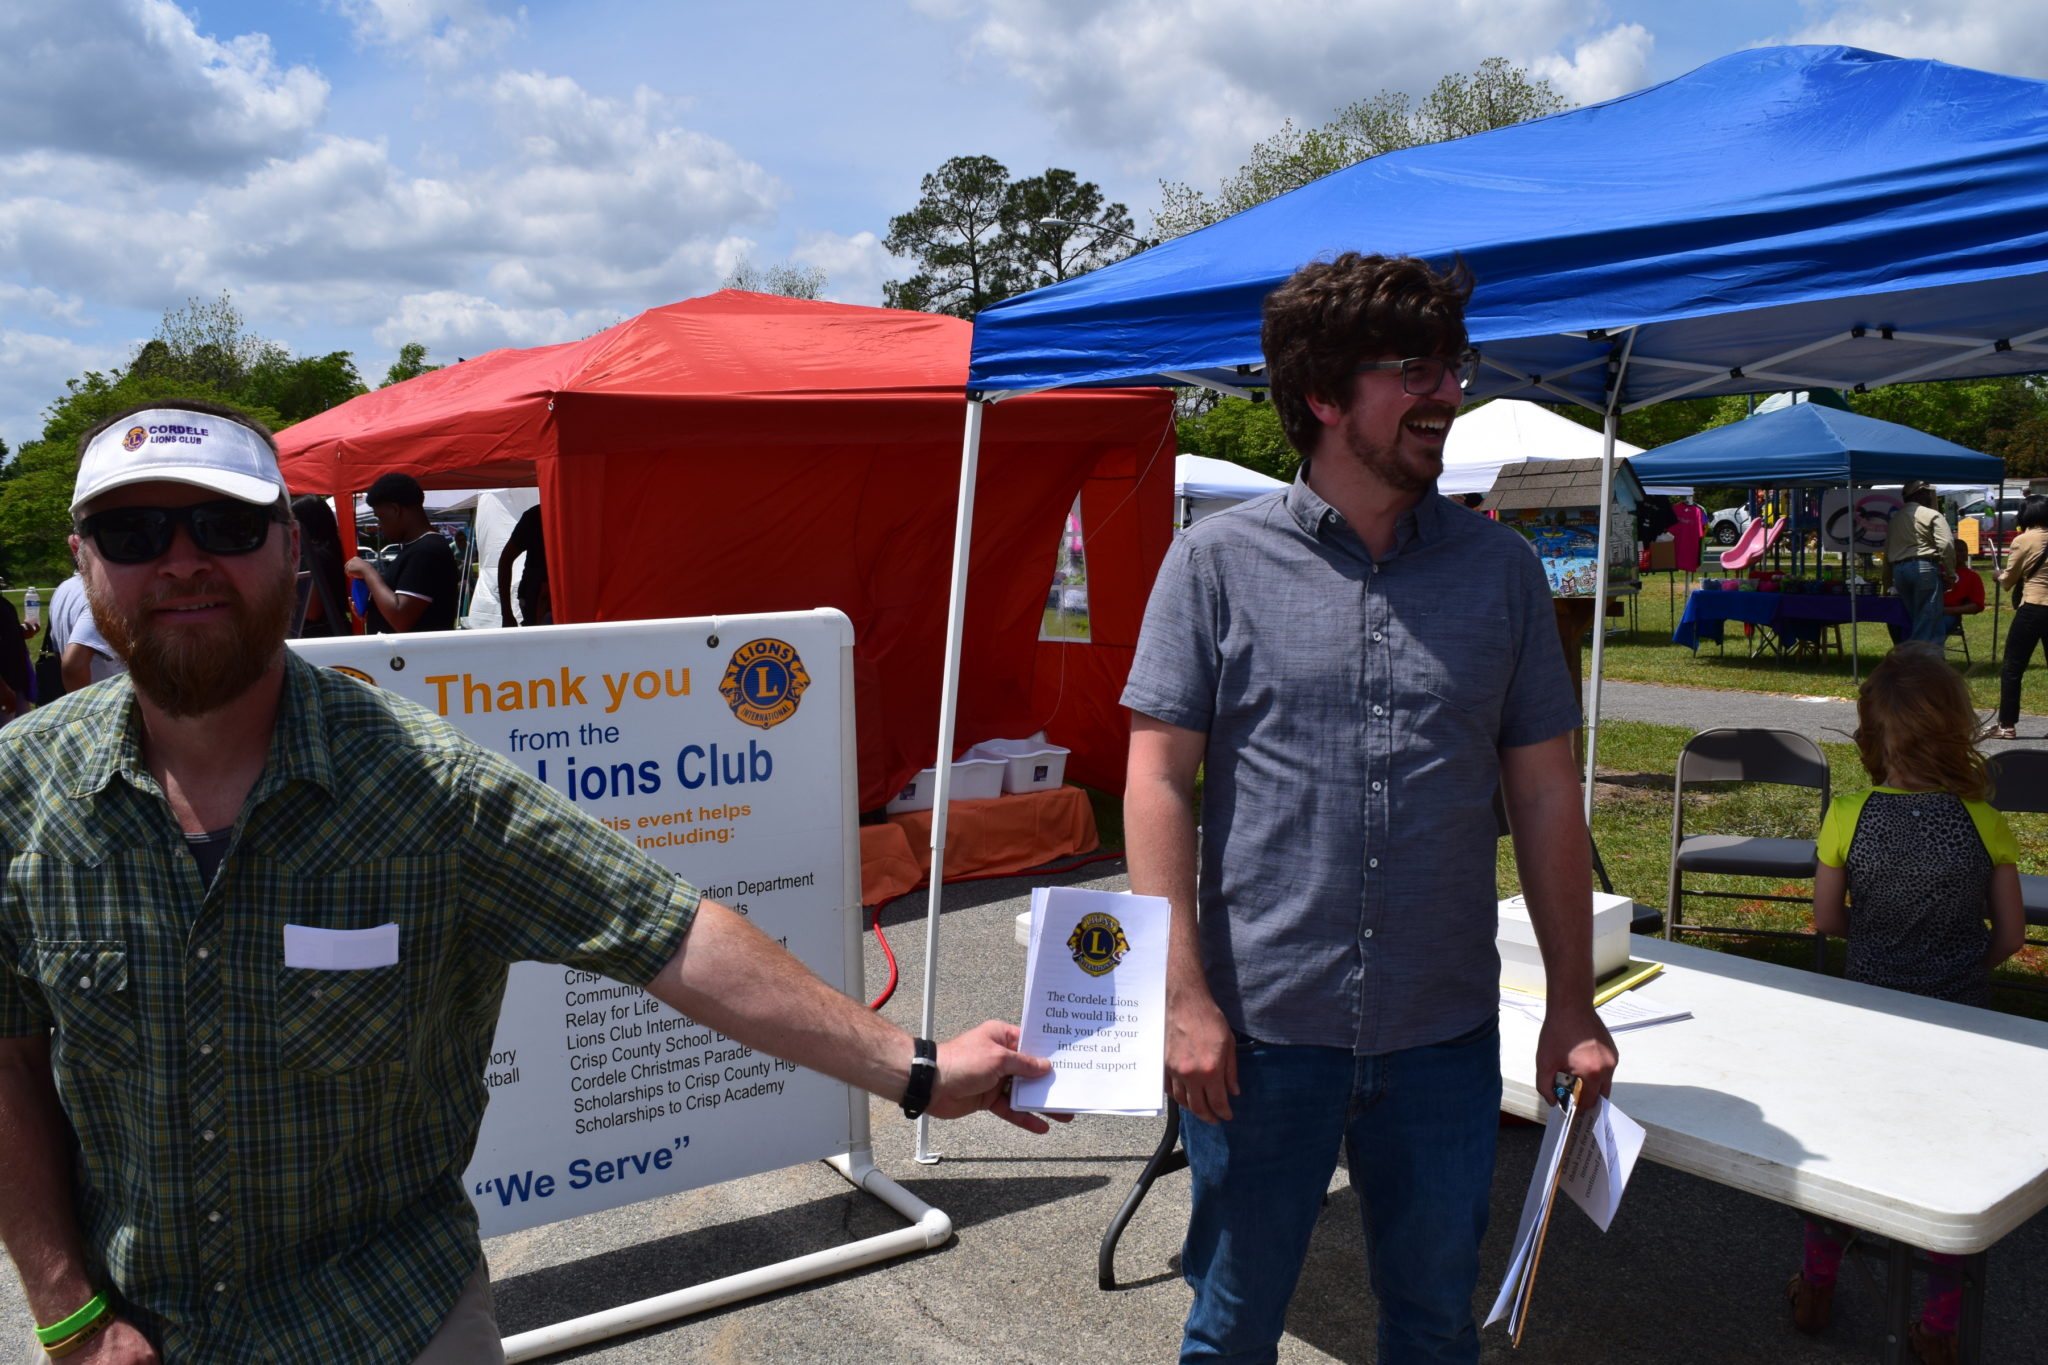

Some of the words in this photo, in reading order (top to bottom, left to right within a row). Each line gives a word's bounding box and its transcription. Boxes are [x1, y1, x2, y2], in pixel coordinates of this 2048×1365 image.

[148, 425, 209, 436] CORDELE
[150, 436, 177, 444] LIONS
[179, 436, 202, 445] CLUB
[739, 642, 791, 663] LIONS
[425, 667, 588, 717] Thank
[602, 668, 691, 714] you
[756, 667, 778, 697] L
[743, 704, 791, 721] INTERNATIONAL
[509, 728, 570, 752] from
[579, 723, 620, 746] the
[677, 740, 773, 790] Club
[600, 816, 631, 831] his
[637, 808, 693, 828] event
[699, 803, 752, 821] helps
[636, 827, 735, 849] including:
[700, 884, 733, 899] ation
[737, 871, 814, 897] Department
[1090, 931, 1106, 954] L
[564, 969, 602, 985] Crisp
[565, 985, 645, 1007] Community
[1047, 991, 1065, 1002] The
[1068, 993, 1107, 1005] Cordele
[1110, 996, 1139, 1007] Lions
[566, 1010, 606, 1028] Relay
[611, 1005, 630, 1020] for
[634, 999, 659, 1016] Life
[1045, 1007, 1069, 1018] Club
[1071, 1010, 1103, 1021] would
[1106, 1011, 1125, 1022] like
[1127, 1014, 1138, 1022] to
[567, 1032, 605, 1050] Lions
[610, 1023, 642, 1041] Club
[1042, 1023, 1072, 1035] thank
[1074, 1028, 1094, 1038] you
[1096, 1027, 1112, 1037] for
[1114, 1030, 1140, 1040] your
[570, 1053, 607, 1070] Crisp
[612, 1042, 661, 1062] County
[665, 1030, 712, 1052] School
[1057, 1040, 1098, 1052] interest
[1100, 1043, 1121, 1053] and
[571, 1069, 627, 1092] Cordele
[631, 1056, 700, 1080] Christmas
[704, 1045, 752, 1065] Parade
[1050, 1059, 1093, 1070] ntinued
[1095, 1060, 1137, 1073] support
[483, 1067, 520, 1088] otball
[574, 1084, 664, 1113] Scholarships
[668, 1080, 681, 1093] to
[685, 1073, 720, 1090] Crisp
[724, 1061, 771, 1081] County
[775, 1058, 799, 1072] Hig
[575, 1105, 665, 1134] Scholarships
[669, 1101, 682, 1114] to
[686, 1094, 721, 1110] Crisp
[724, 1080, 785, 1102] Academy
